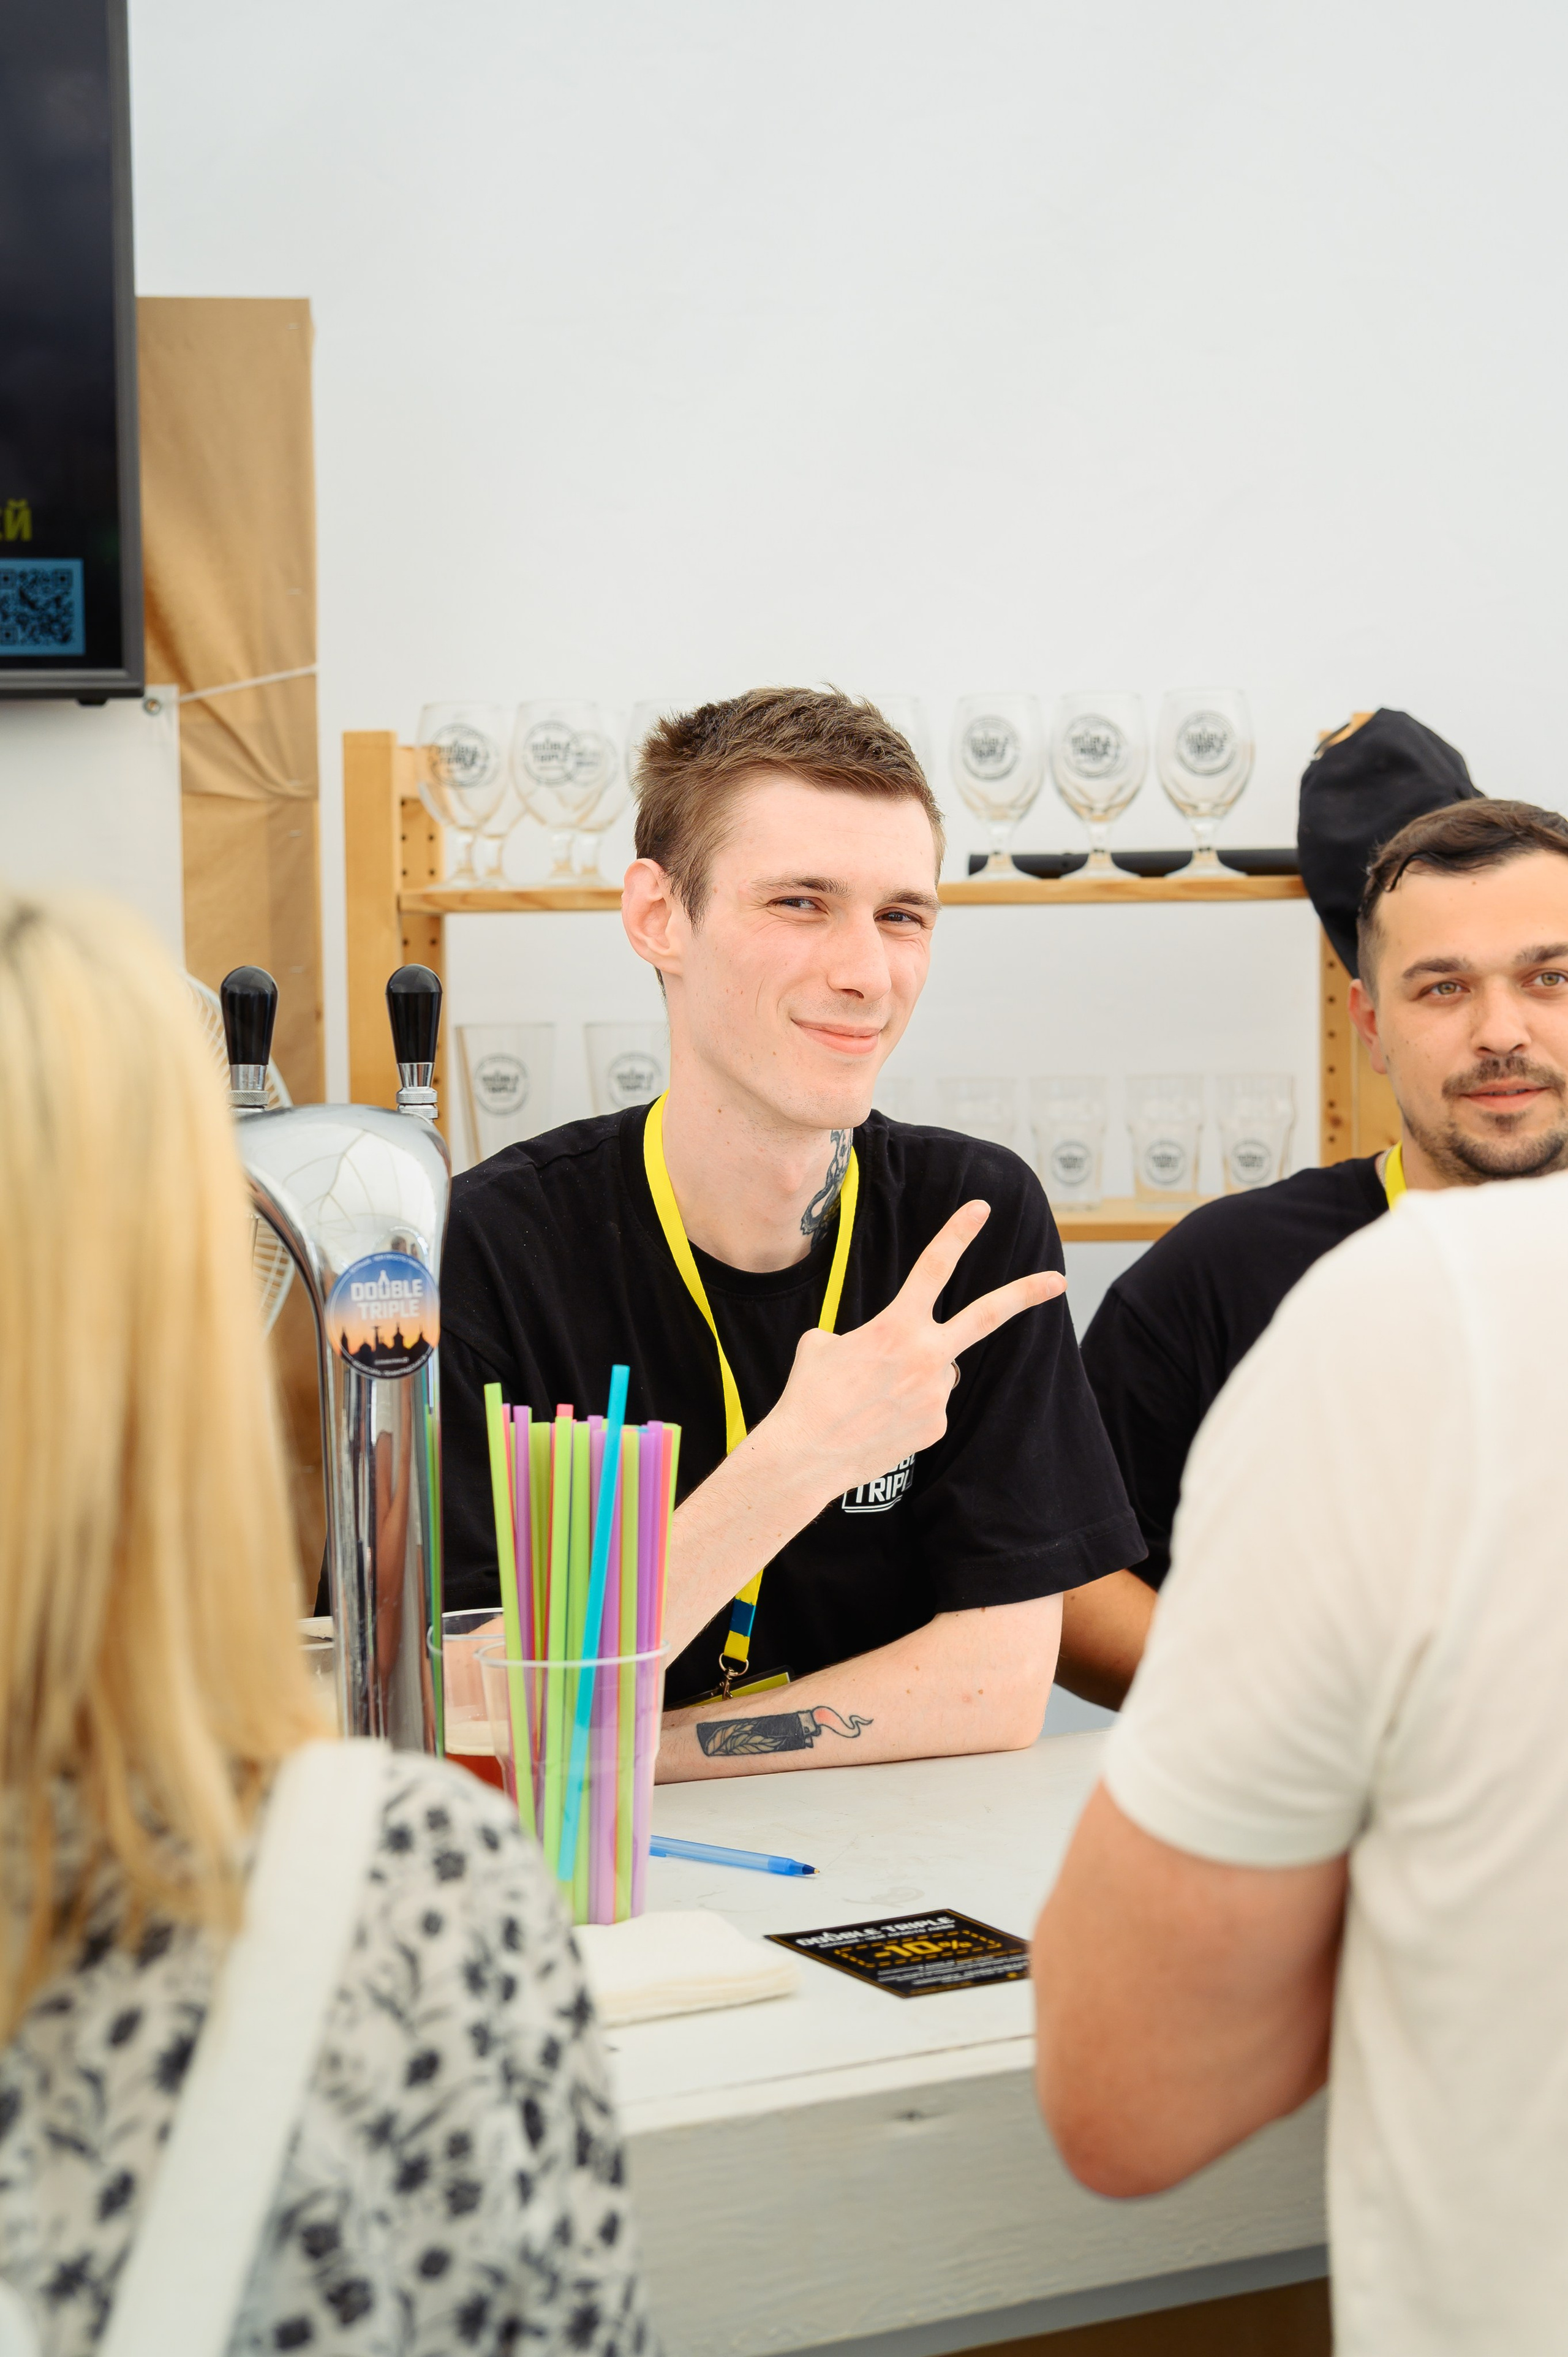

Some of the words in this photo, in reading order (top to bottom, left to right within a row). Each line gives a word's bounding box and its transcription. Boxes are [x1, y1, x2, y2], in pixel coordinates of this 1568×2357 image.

[0, 498, 32, 541] Й
[352, 1270, 423, 1300] DOUBLE
[358, 1299, 420, 1319] TRIPLE
[796, 1928, 882, 1946] DOUBLE
[880, 1917, 956, 1933] TRIPLE
[874, 1940, 973, 1957] -10%
